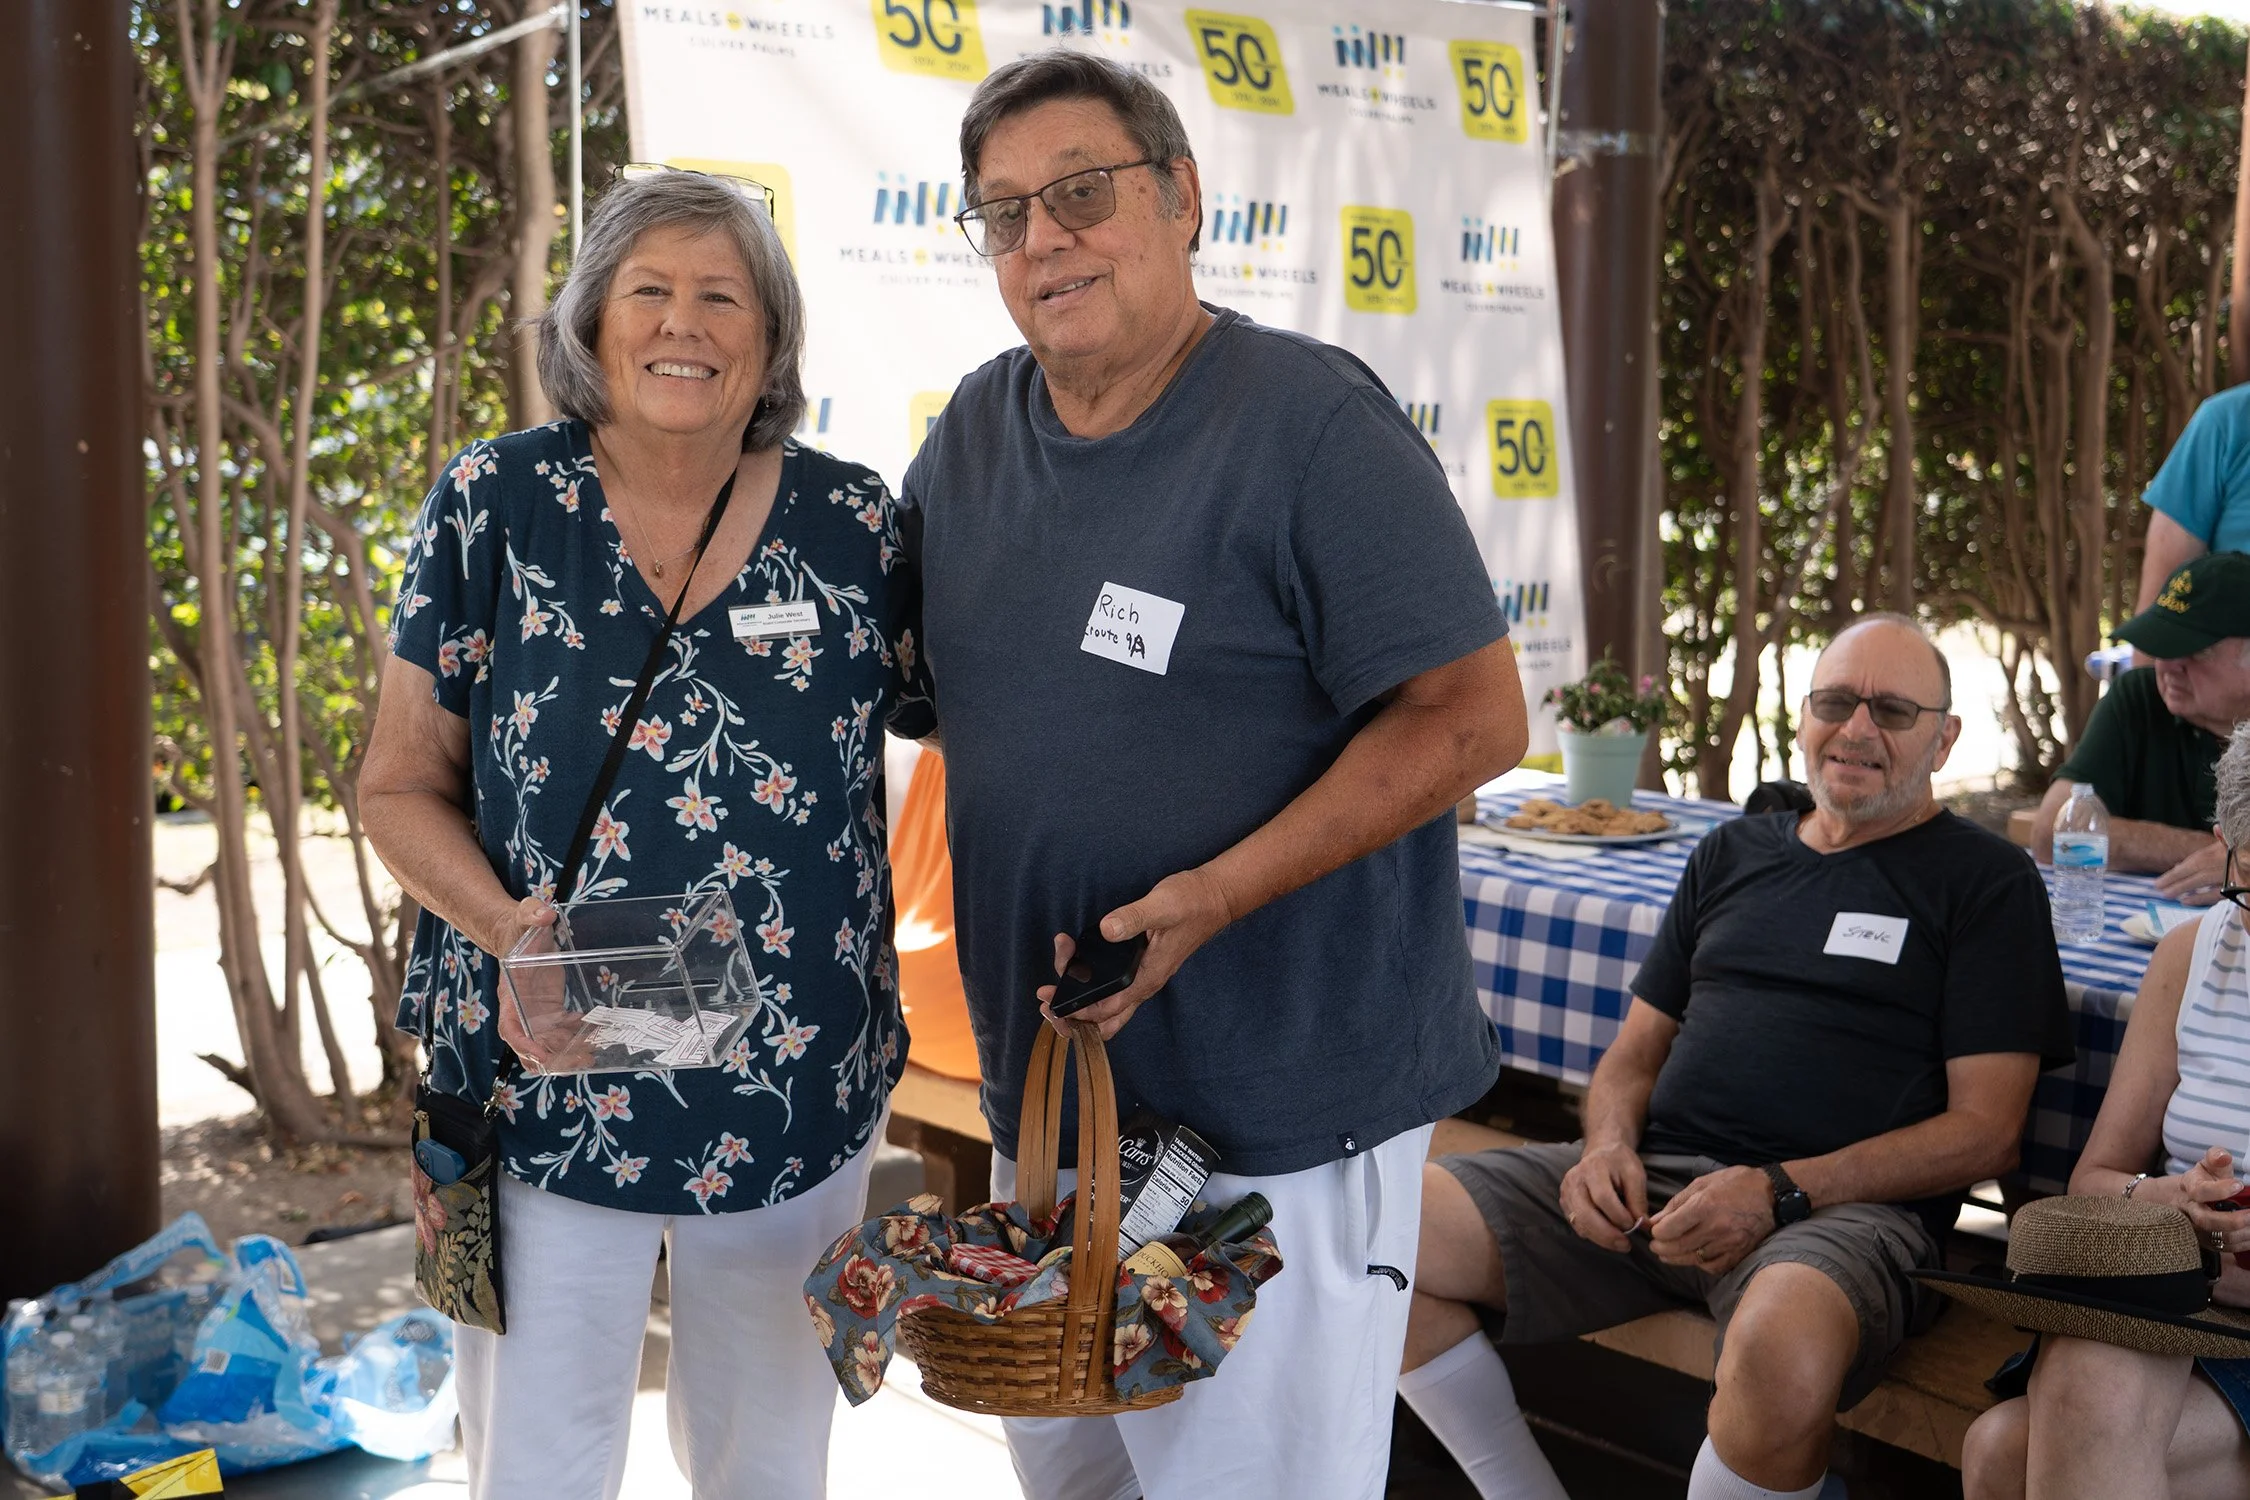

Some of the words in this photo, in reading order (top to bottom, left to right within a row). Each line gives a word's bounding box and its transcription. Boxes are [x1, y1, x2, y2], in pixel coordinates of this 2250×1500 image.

[644, 7, 721, 26] MEALS
[747, 16, 835, 38] WHEELS
[885, 0, 963, 54] 50
[1201, 28, 1272, 91] 50
[1463, 59, 1513, 119] 50
[840, 248, 908, 263] MEALS
[1351, 228, 1402, 290] 50
[1195, 264, 1239, 279] EALS
[1496, 419, 1545, 477] 50
[1099, 594, 1139, 624] Rich
[1089, 626, 1118, 644] route
[1170, 1143, 1192, 1163] CRACKERS
[1174, 1137, 1188, 1151] TABLE
[1165, 1151, 1189, 1173] Nutrition
[1187, 1170, 1203, 1185] Facts
[1151, 1174, 1172, 1192] Calories
[1180, 1195, 1190, 1206] 50
